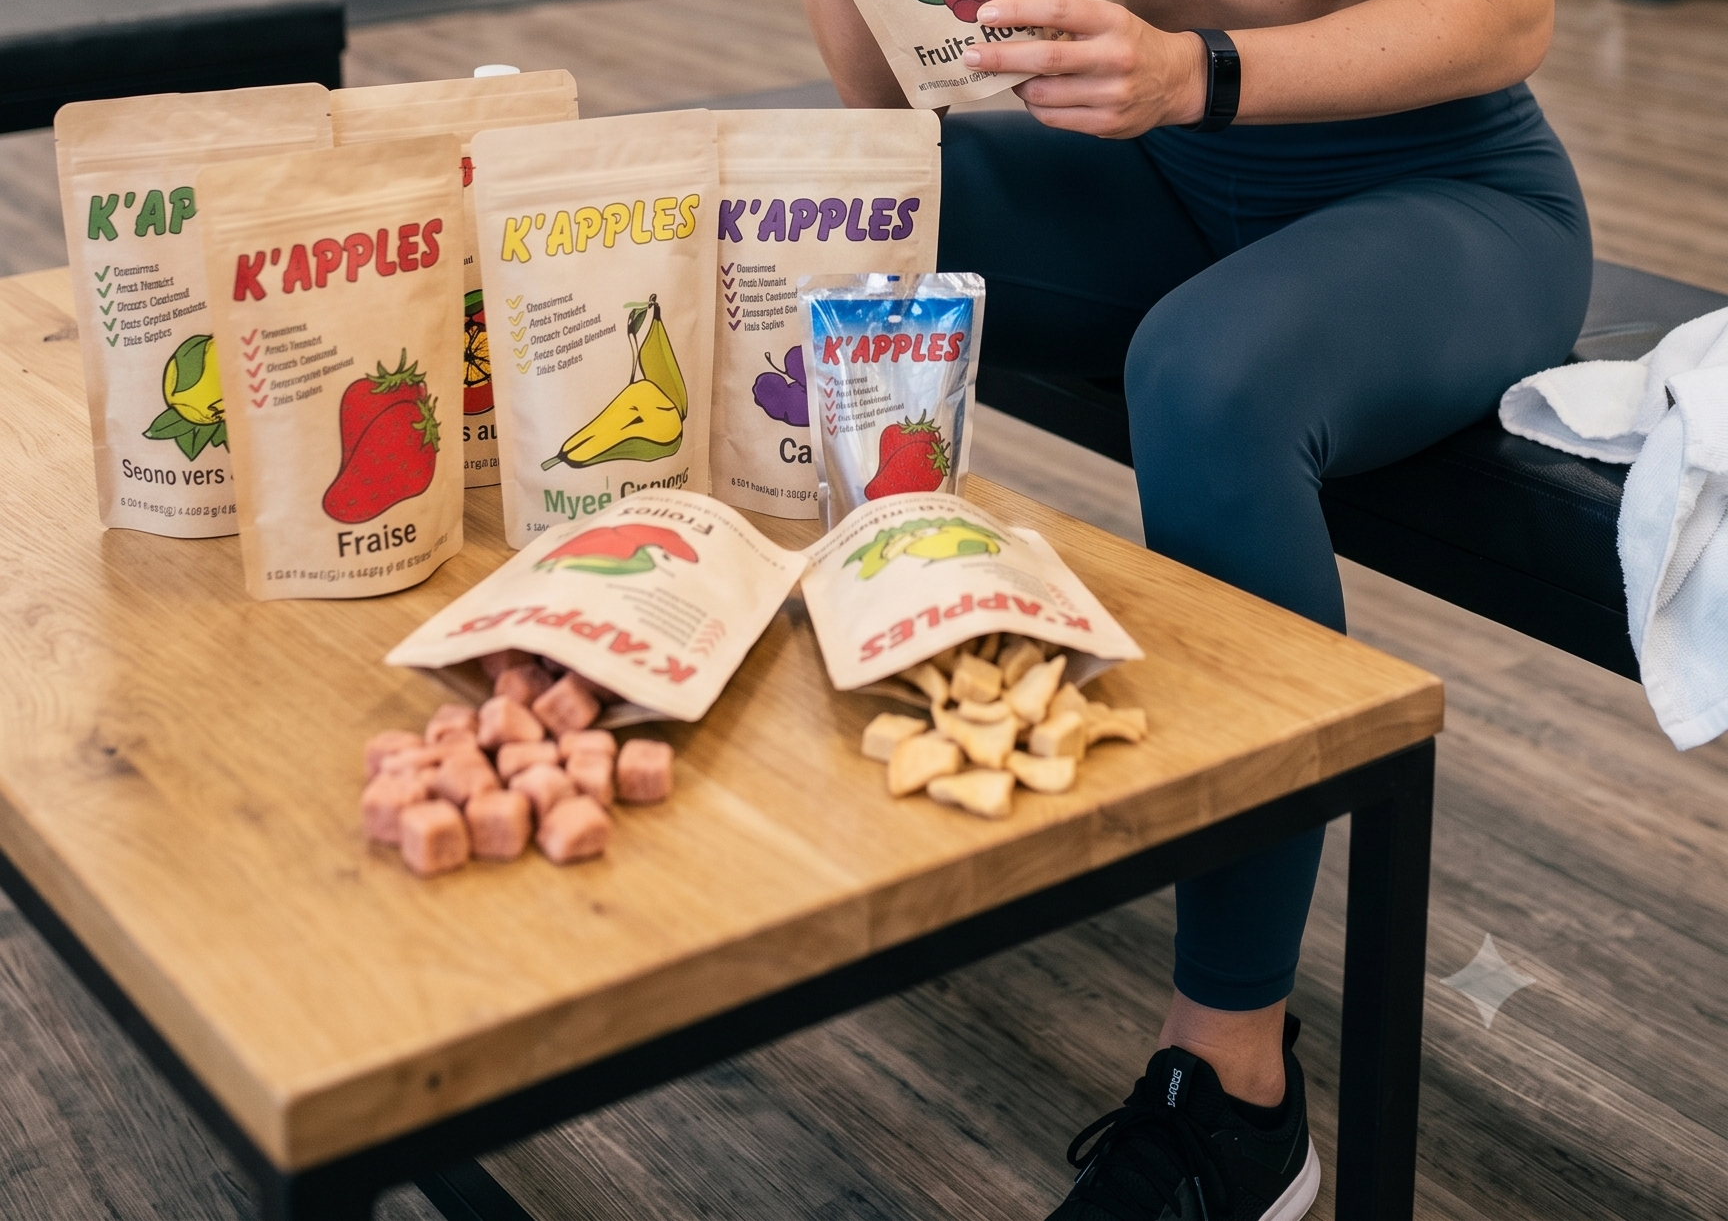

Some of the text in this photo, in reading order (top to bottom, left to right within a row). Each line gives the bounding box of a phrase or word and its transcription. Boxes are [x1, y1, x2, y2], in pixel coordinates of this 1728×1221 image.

[500, 194, 700, 263] K'APPLES
[717, 197, 920, 243] K'APPLES
[232, 218, 444, 302] K'APPLES
[822, 332, 965, 365] K'APPLES
[122, 459, 225, 485] Seono vers
[337, 523, 417, 558] Fraise
